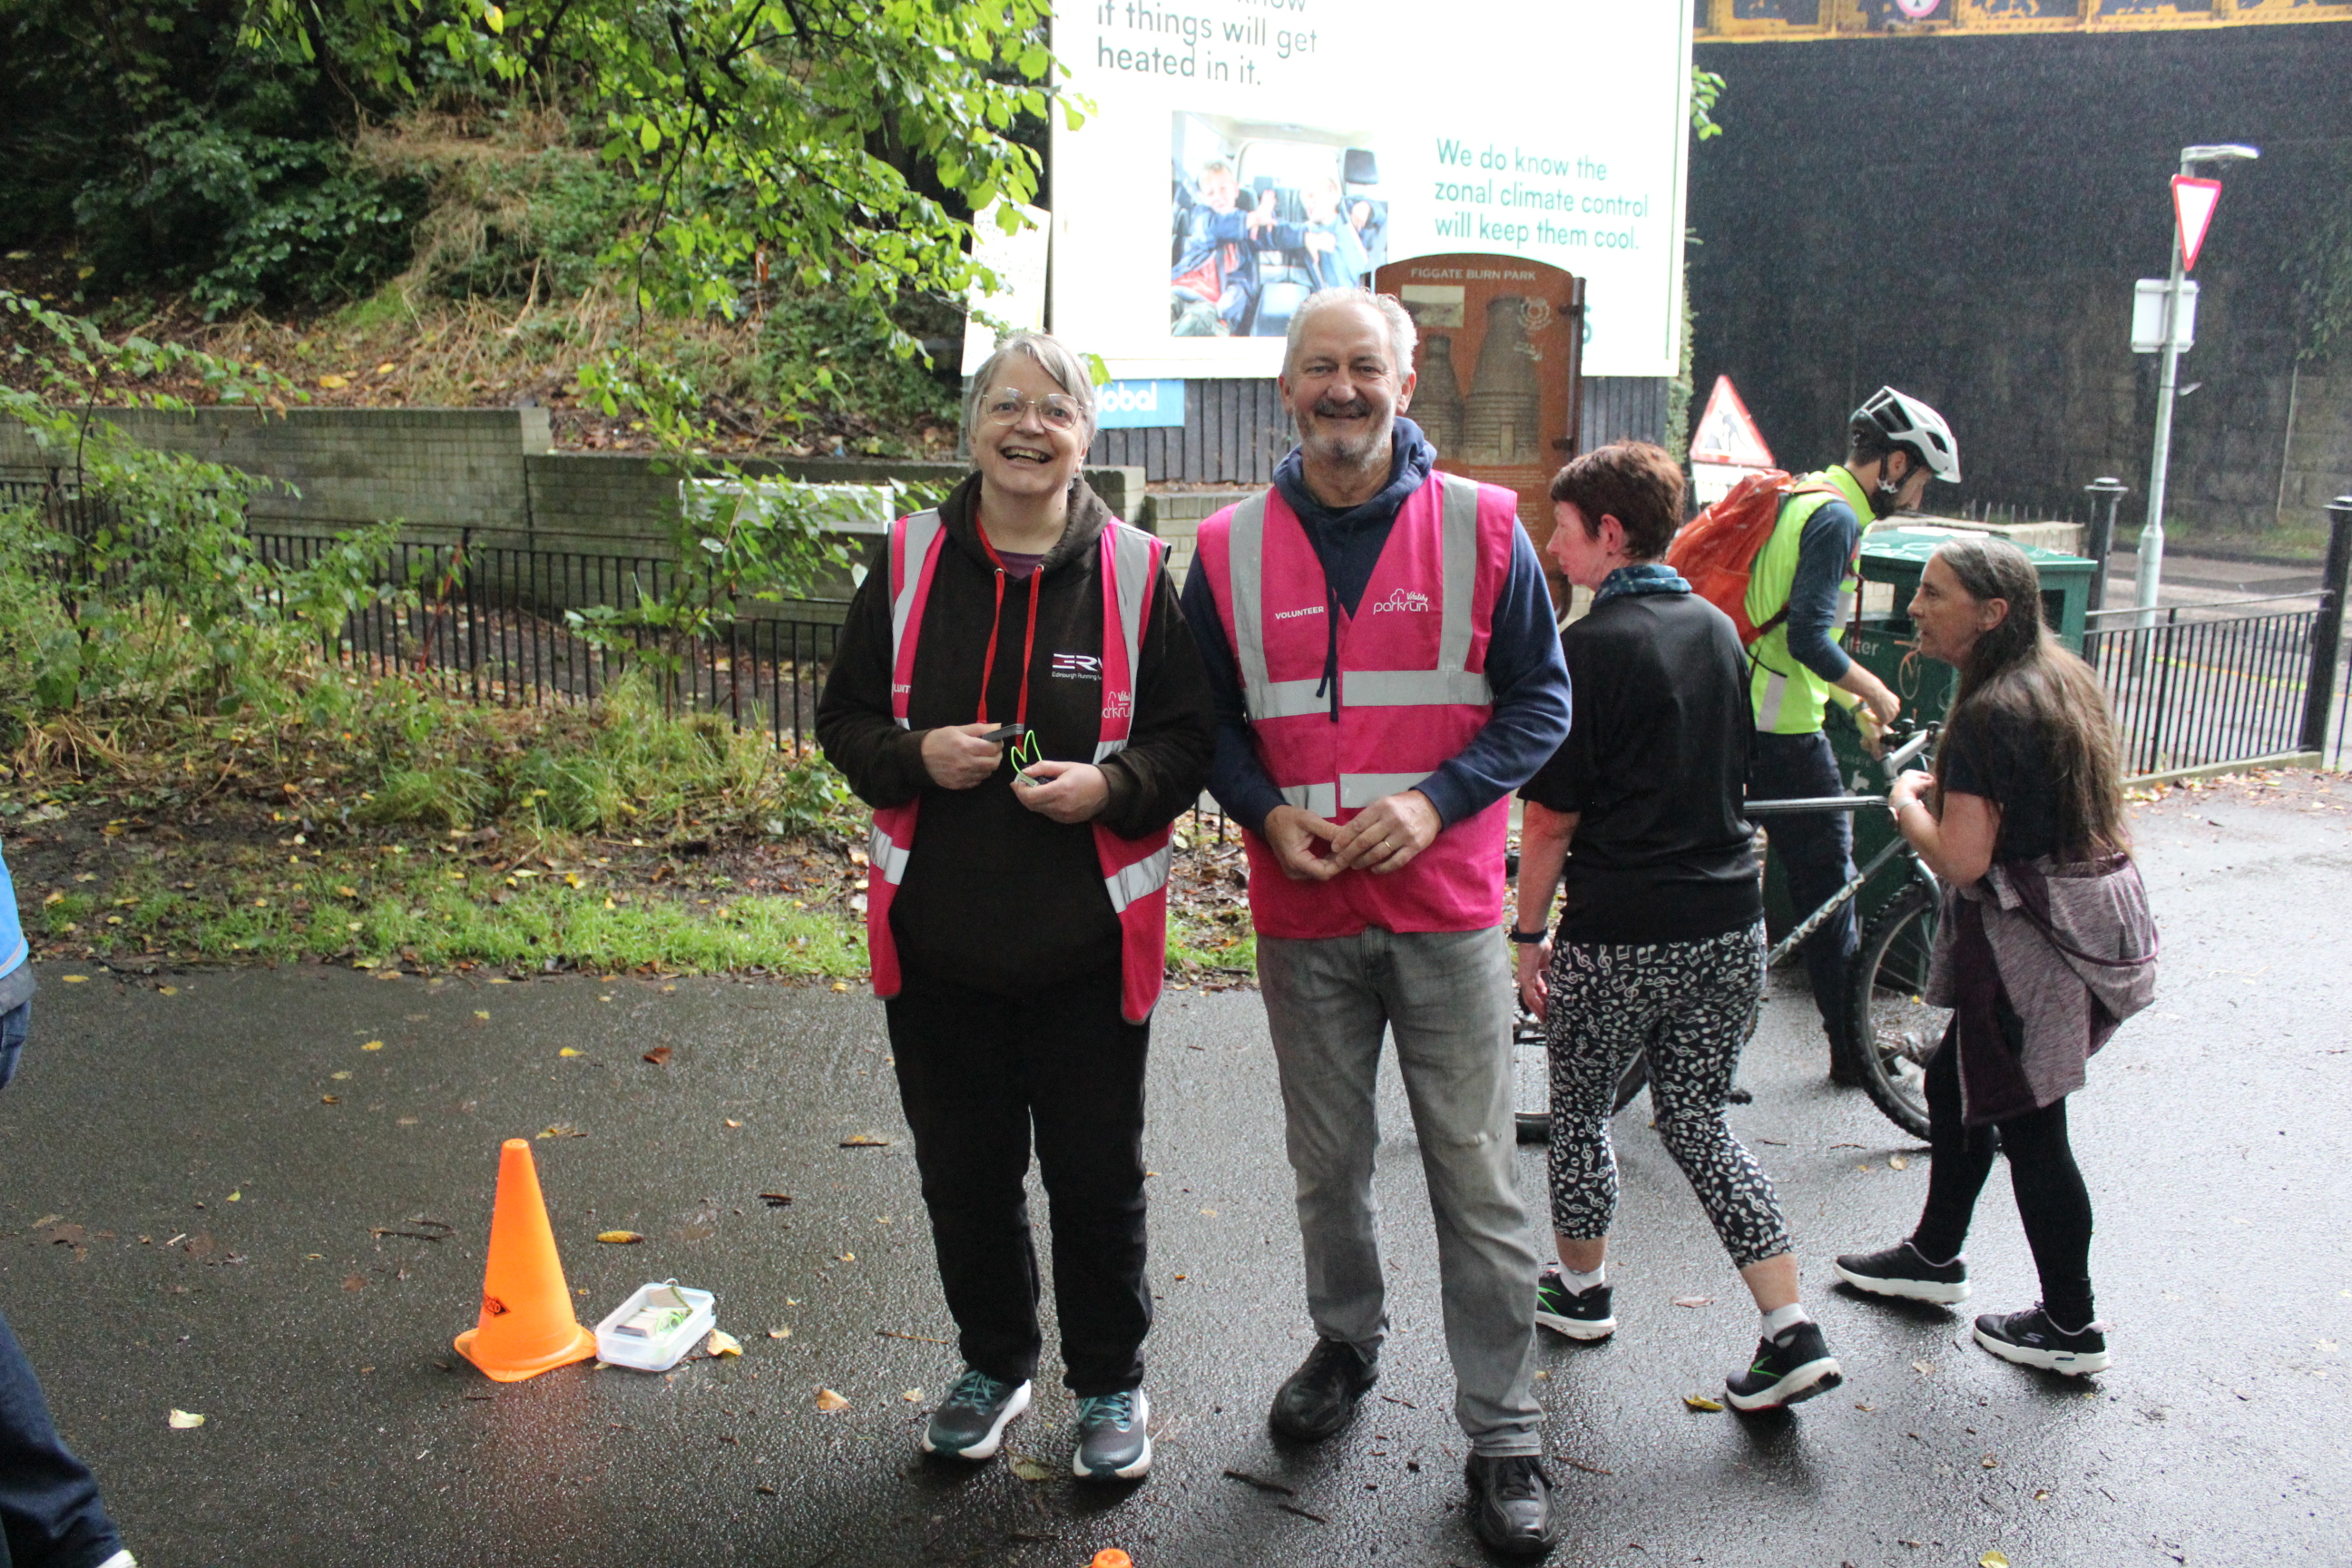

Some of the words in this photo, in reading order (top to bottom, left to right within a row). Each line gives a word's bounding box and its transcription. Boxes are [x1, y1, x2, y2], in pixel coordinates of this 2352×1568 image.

[1125, 0, 1211, 46] things
[1222, 15, 1266, 46] will
[1277, 29, 1318, 59] get
[1097, 35, 1195, 77] heated
[1207, 50, 1229, 81] in
[1240, 54, 1261, 85] it.
[1436, 137, 1472, 167] We
[1480, 143, 1507, 171] do
[1514, 146, 1570, 177] know
[1576, 154, 1607, 181] the
[1435, 178, 1493, 205] zonal
[1500, 181, 1574, 212] climate
[1582, 193, 1649, 218] control
[1435, 211, 1471, 239] will
[1479, 213, 1529, 250] keep
[1537, 219, 1587, 247] them
[1594, 225, 1640, 250] cool.
[1410, 268, 1464, 279] FIGGATE
[1465, 269, 1502, 280] BURN
[1504, 270, 1536, 281] PARK
[1275, 605, 1325, 620] VOLUNTEER
[1372, 595, 1428, 615] parkrun
